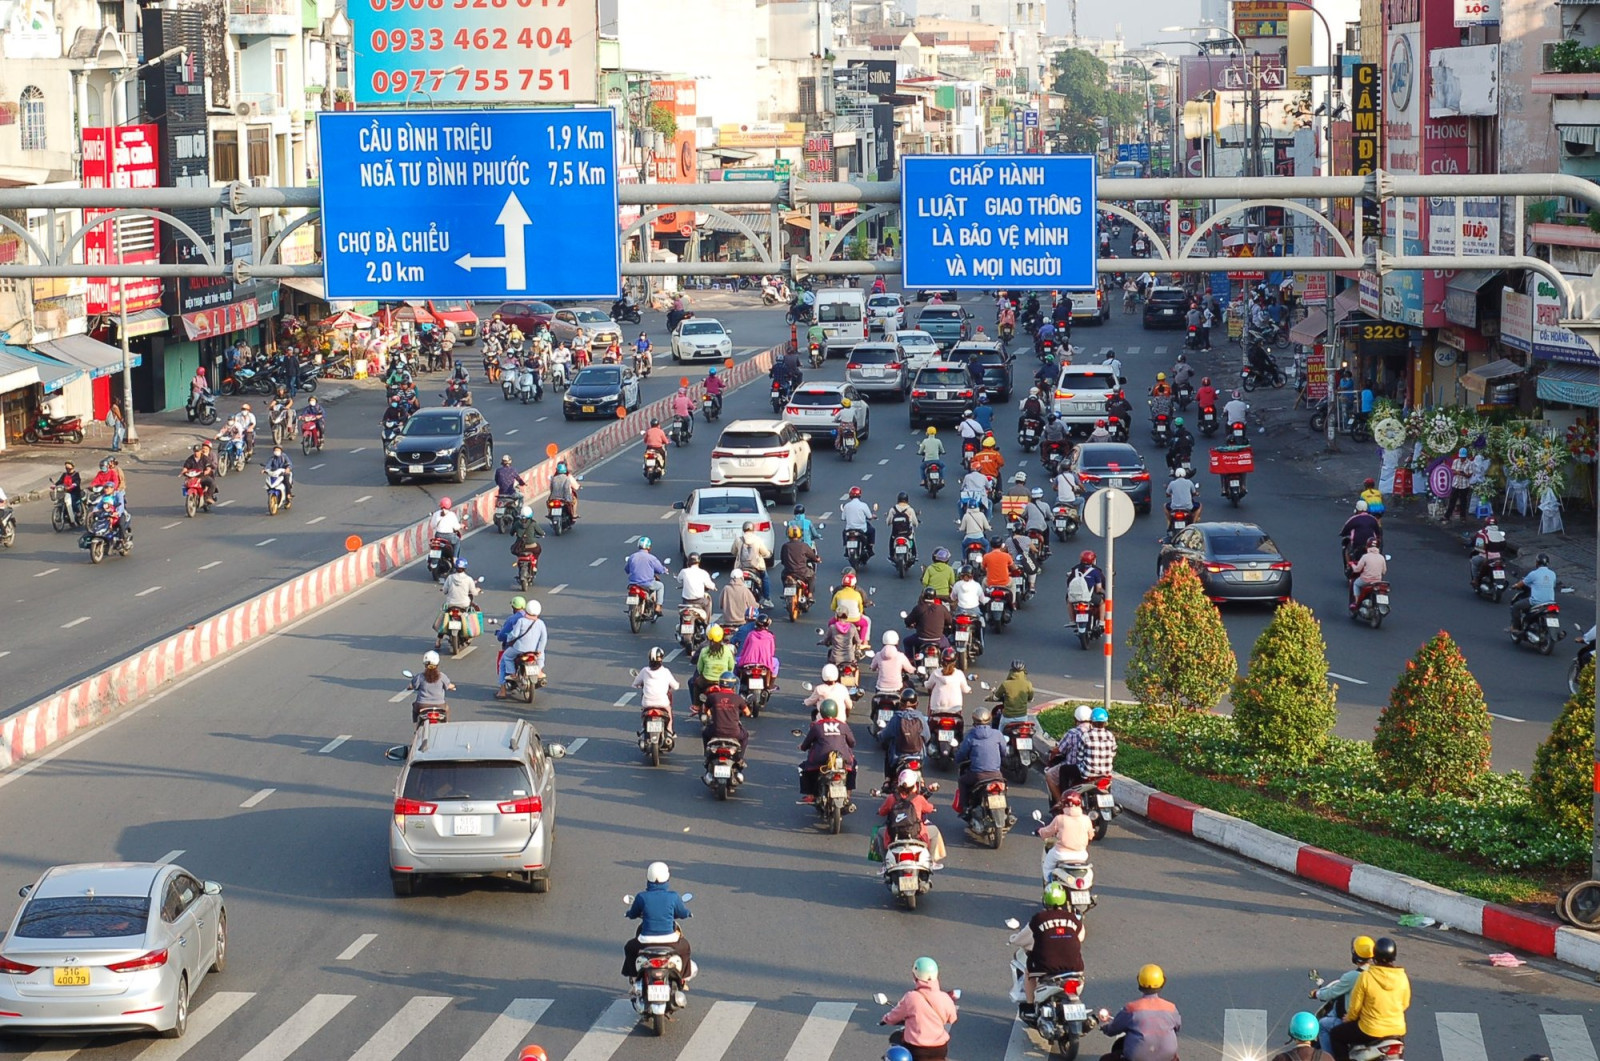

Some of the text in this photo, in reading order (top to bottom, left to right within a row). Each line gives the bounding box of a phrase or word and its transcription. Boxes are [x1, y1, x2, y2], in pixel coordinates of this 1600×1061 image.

[1465, 3, 1489, 15] LỘC
[372, 27, 573, 51] 0933 462 404
[373, 69, 571, 92] 0977 755 751
[1355, 66, 1374, 131] CẦM
[359, 119, 605, 155] CẦU BÌNH TRIỆU 1,9 Km
[1425, 121, 1467, 140] THÔNG
[360, 155, 606, 188] NGÃ TƯ BÌNH PHƯỚC 7,5 Km
[949, 161, 1045, 186] CHẤP HÀNH
[1431, 154, 1459, 174] CỬA
[918, 194, 1082, 220] LUẬT GIAO THÔNG
[338, 231, 371, 255] CHỢ
[376, 227, 398, 253] BÀ
[402, 222, 450, 252] CHIỂU
[932, 222, 1069, 249] LÀ BẢO VỆ MÌNH
[366, 261, 424, 283] 2,0 km
[946, 252, 1062, 280] VÀ MỌI NGƯỜI
[1363, 325, 1406, 340] 322C
[823, 722, 840, 733] NK
[1038, 918, 1078, 933] VIETNAM
[57, 976, 86, 985] 400.79
[63, 966, 80, 976] 51G
